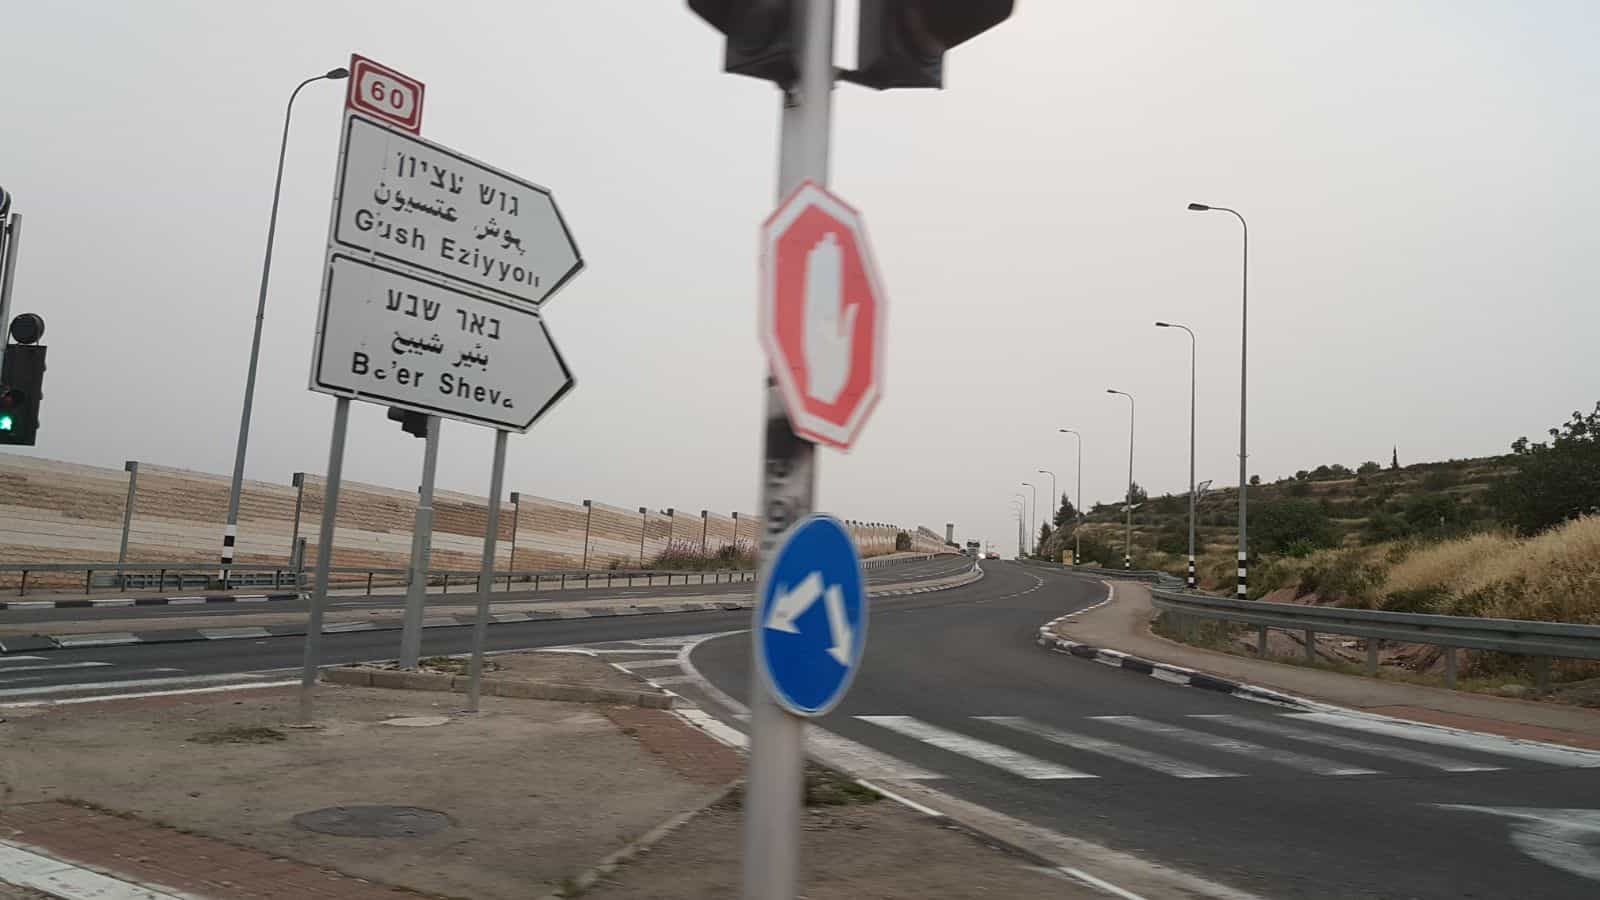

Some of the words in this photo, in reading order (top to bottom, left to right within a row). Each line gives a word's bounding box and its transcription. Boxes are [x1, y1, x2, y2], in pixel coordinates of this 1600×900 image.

[370, 80, 404, 110] 60
[479, 183, 519, 217] גוש
[386, 289, 441, 321] שבע
[456, 308, 500, 340] באר
